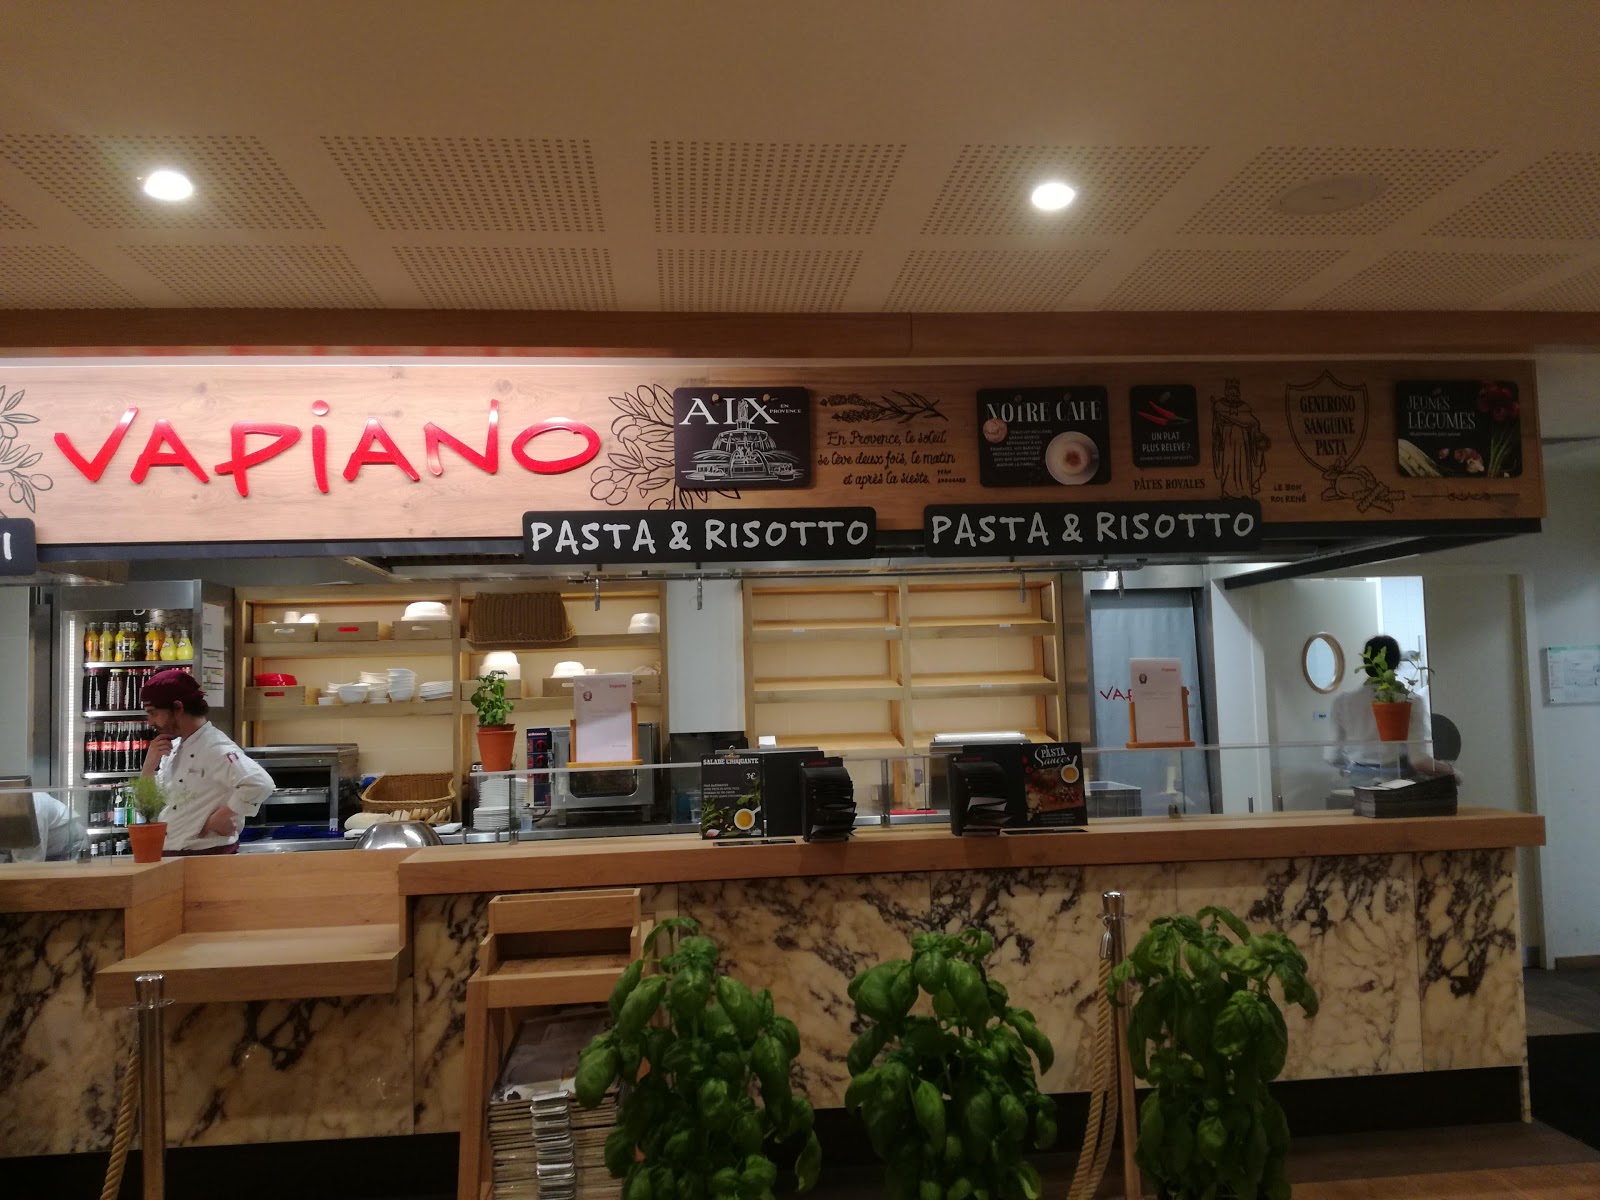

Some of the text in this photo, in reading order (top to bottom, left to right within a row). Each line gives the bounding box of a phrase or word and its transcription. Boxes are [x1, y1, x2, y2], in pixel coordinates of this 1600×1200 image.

[679, 397, 780, 425] AIX
[827, 431, 847, 446] En
[905, 430, 915, 444] le
[917, 430, 947, 444] soleil
[1151, 431, 1180, 441] UN PLAT
[1142, 442, 1160, 452] PLUS
[1315, 439, 1347, 456] PASTA
[817, 455, 830, 466] se
[831, 451, 853, 466] lève
[855, 452, 884, 465] deux
[911, 450, 921, 464] le
[923, 452, 956, 465] matin
[843, 473, 853, 485] et
[855, 473, 883, 490] après
[885, 471, 898, 484] la
[1165, 478, 1206, 490] ROYALES
[531, 519, 869, 555] PASTA & RISOTTO
[931, 512, 1255, 547] PASTA & RISOTTO
[1040, 746, 1067, 758] PASTA
